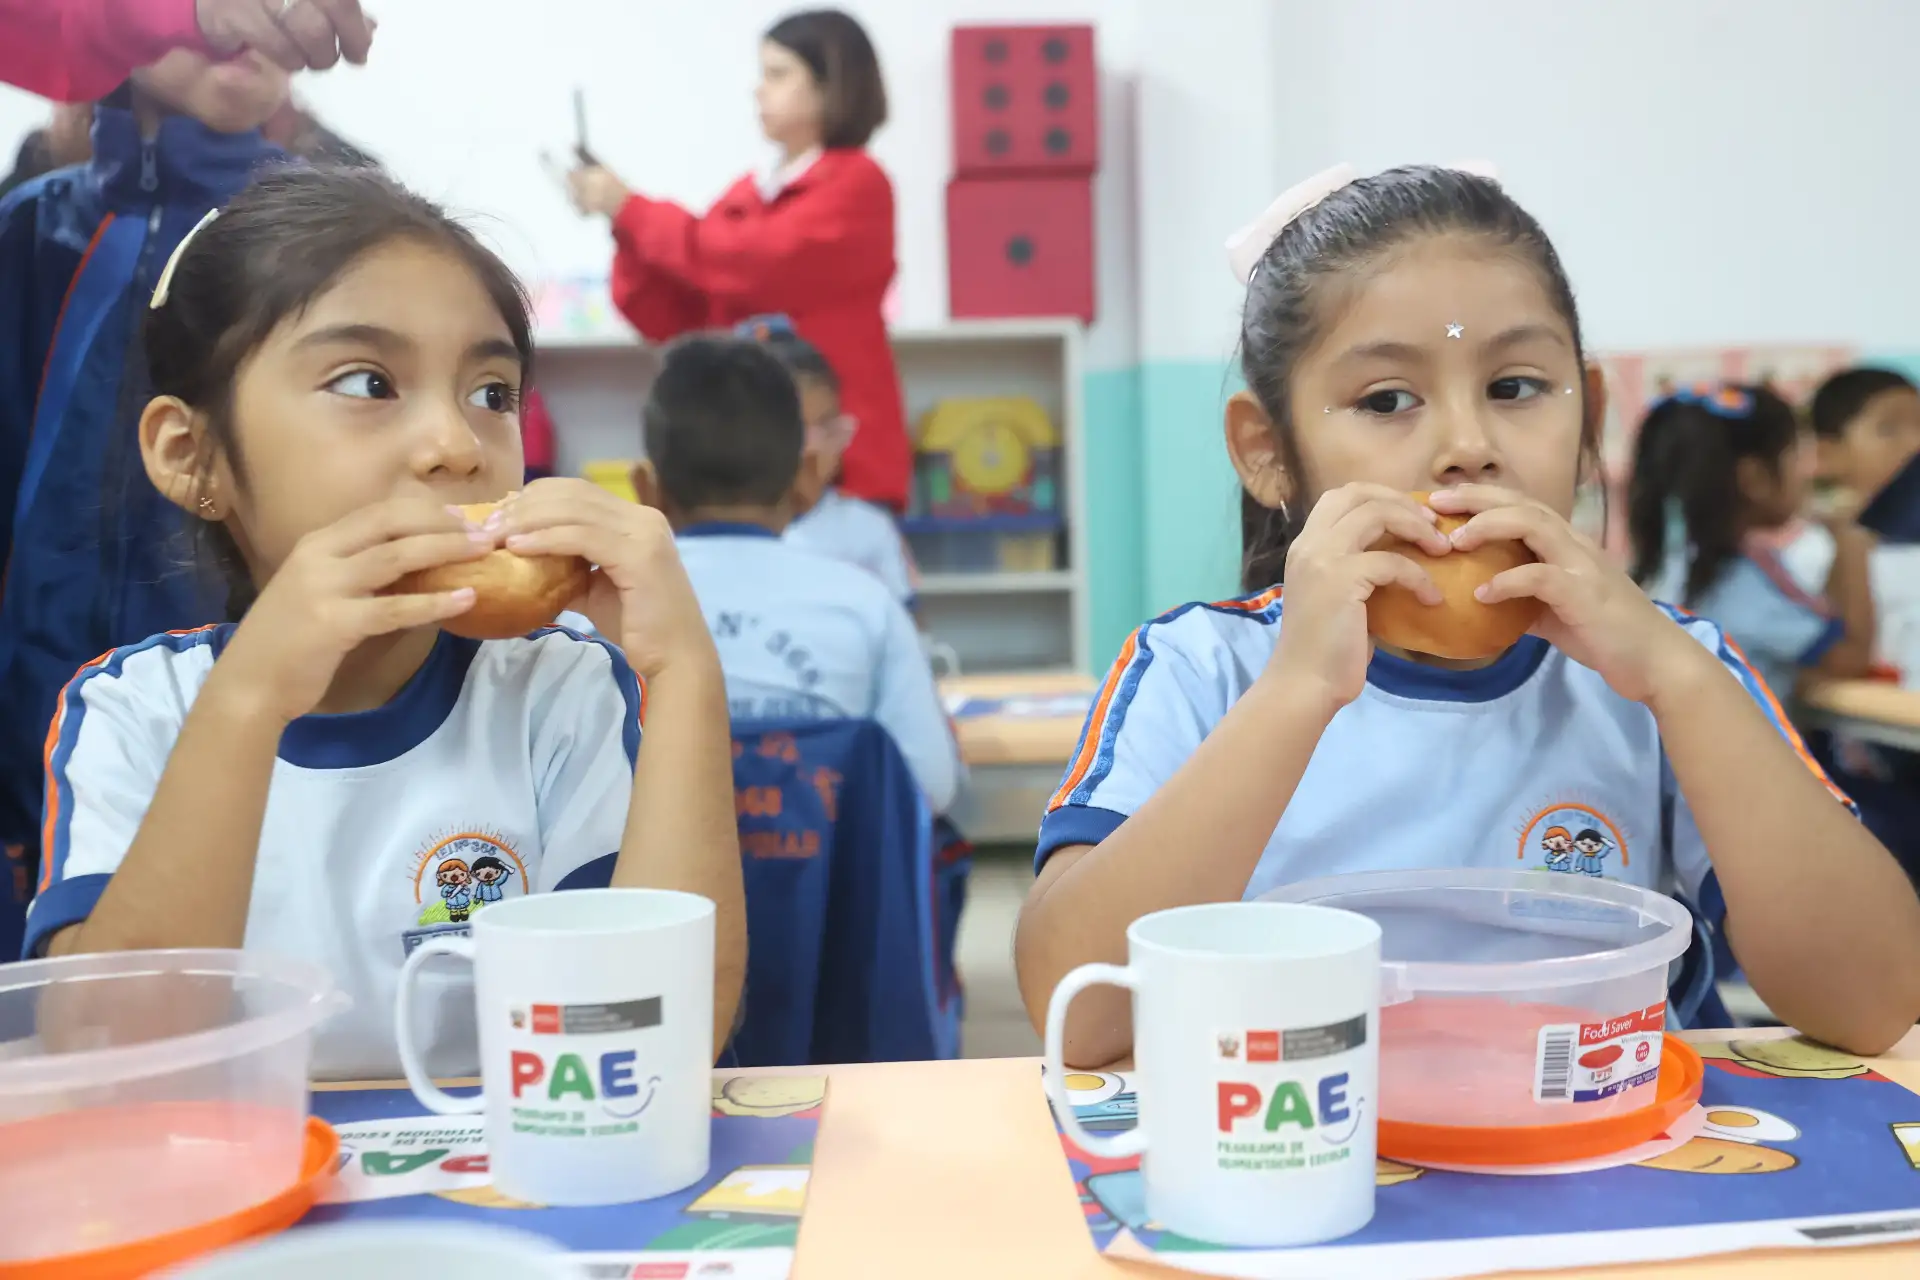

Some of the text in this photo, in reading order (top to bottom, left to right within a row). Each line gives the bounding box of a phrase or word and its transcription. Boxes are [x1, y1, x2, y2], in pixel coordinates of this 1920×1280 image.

[1583, 1022, 1610, 1040] Food
[1610, 1019, 1633, 1035] Saver
[510, 1049, 638, 1101] PAE
[1217, 1071, 1350, 1133] PAE
